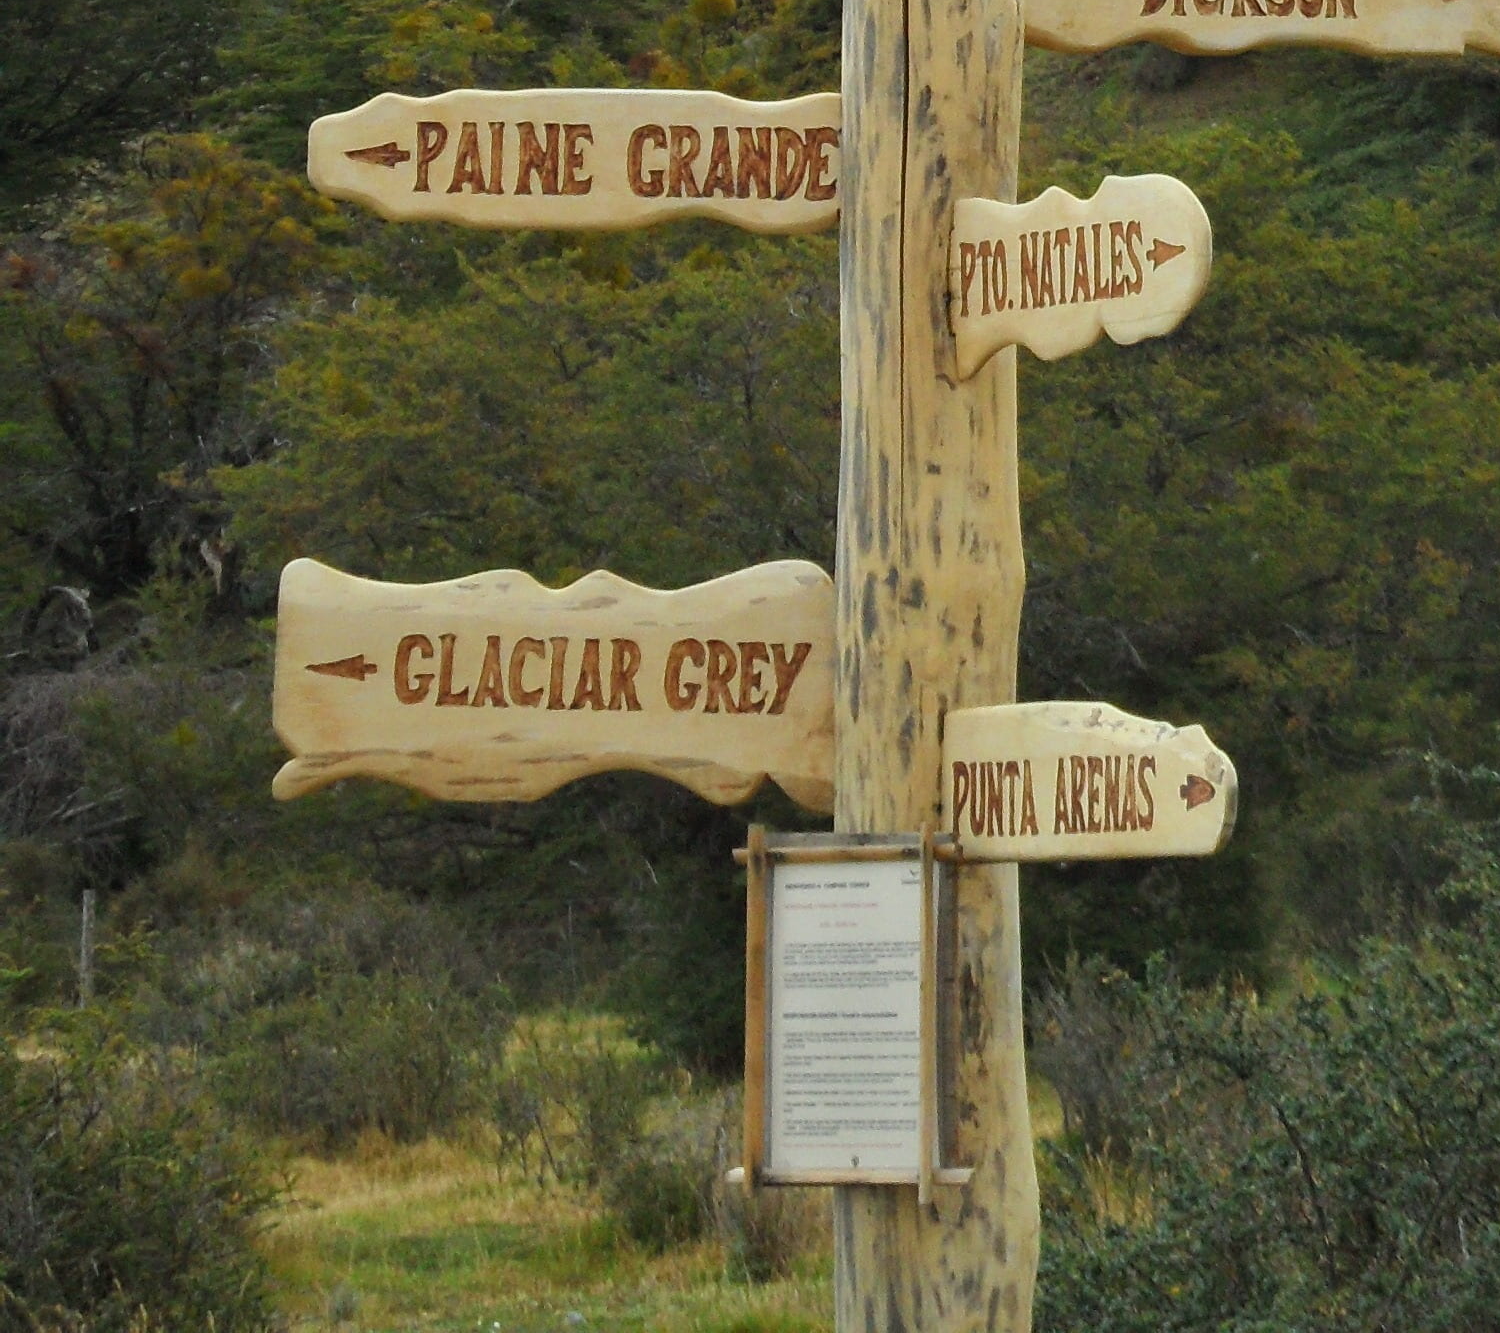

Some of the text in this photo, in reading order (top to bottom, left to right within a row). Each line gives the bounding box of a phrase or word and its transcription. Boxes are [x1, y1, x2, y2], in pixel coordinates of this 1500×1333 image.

[412, 121, 840, 201] PAINE GRANDE
[960, 220, 1143, 318] PTO. NATALES
[394, 633, 812, 715] GLACIAR GREY
[952, 754, 1157, 837] PUNTA ARENAS
